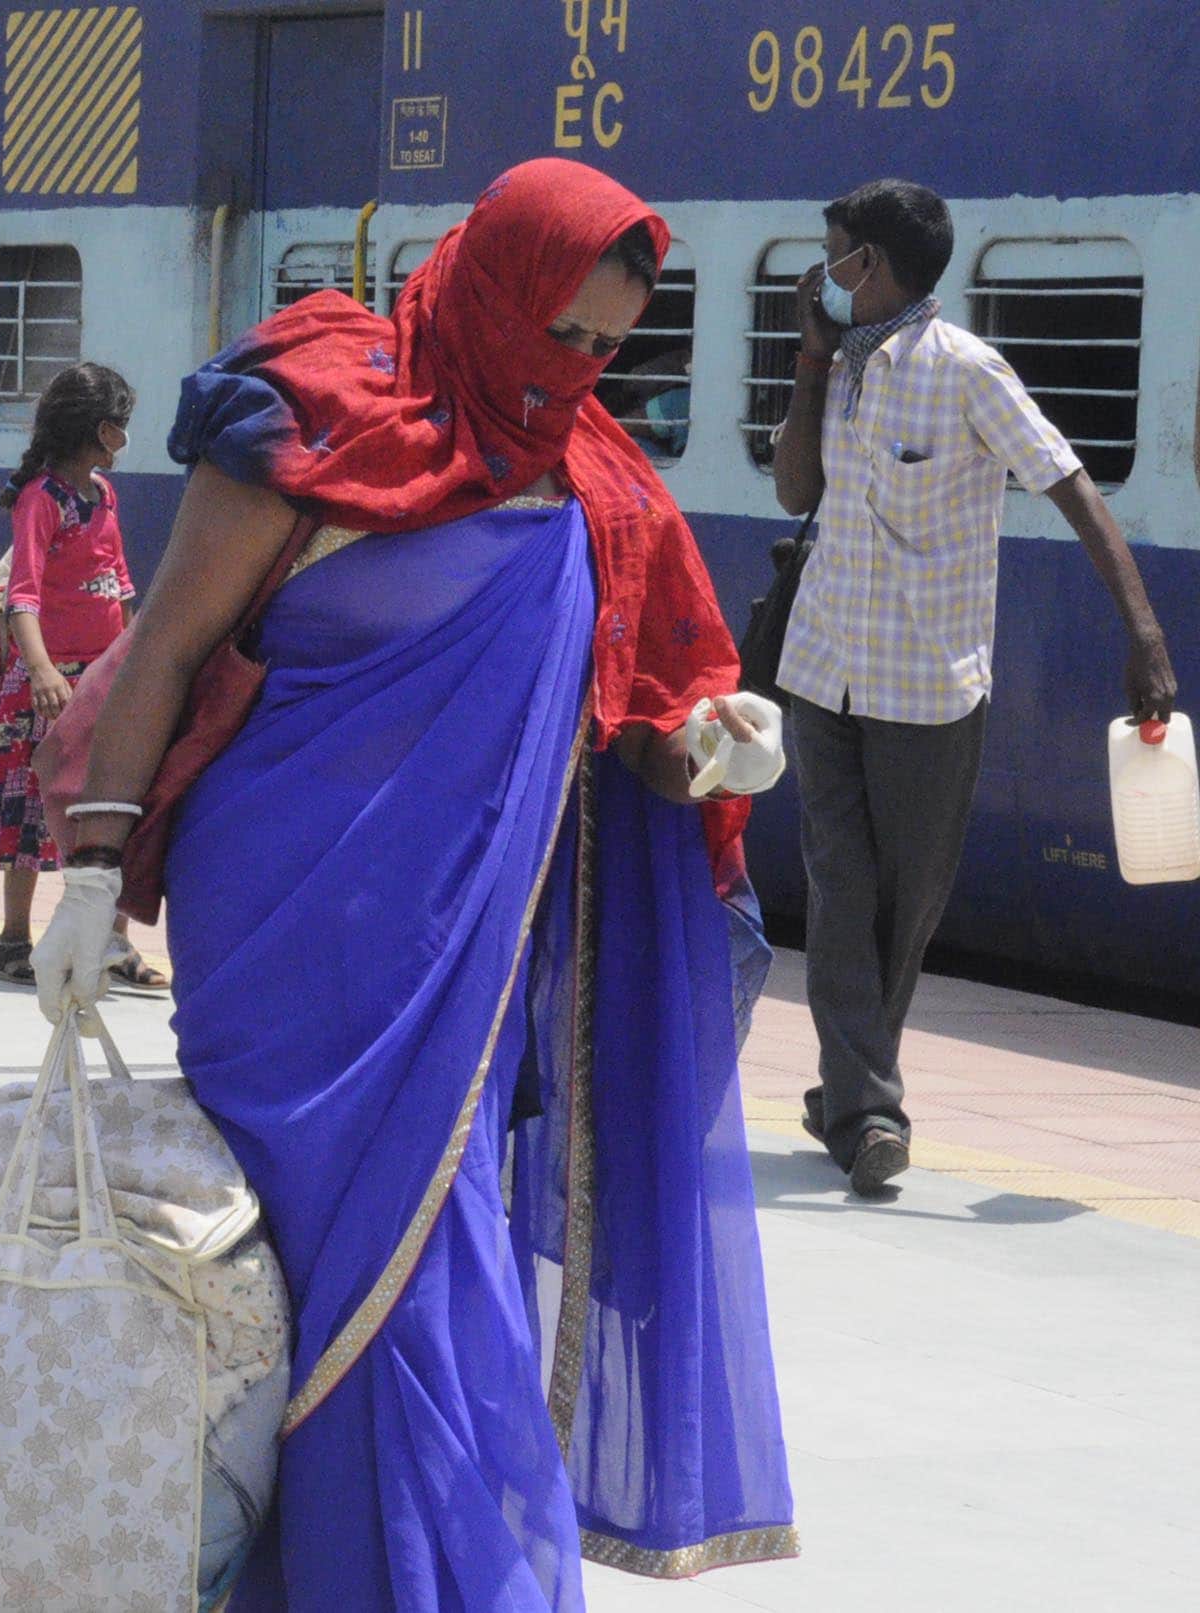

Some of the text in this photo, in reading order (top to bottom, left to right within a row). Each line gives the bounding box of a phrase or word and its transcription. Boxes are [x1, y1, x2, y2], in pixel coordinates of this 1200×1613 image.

[748, 23, 956, 112] 98425
[400, 148, 436, 163] TO SEAT
[1043, 847, 1106, 870] LIFT HERE
